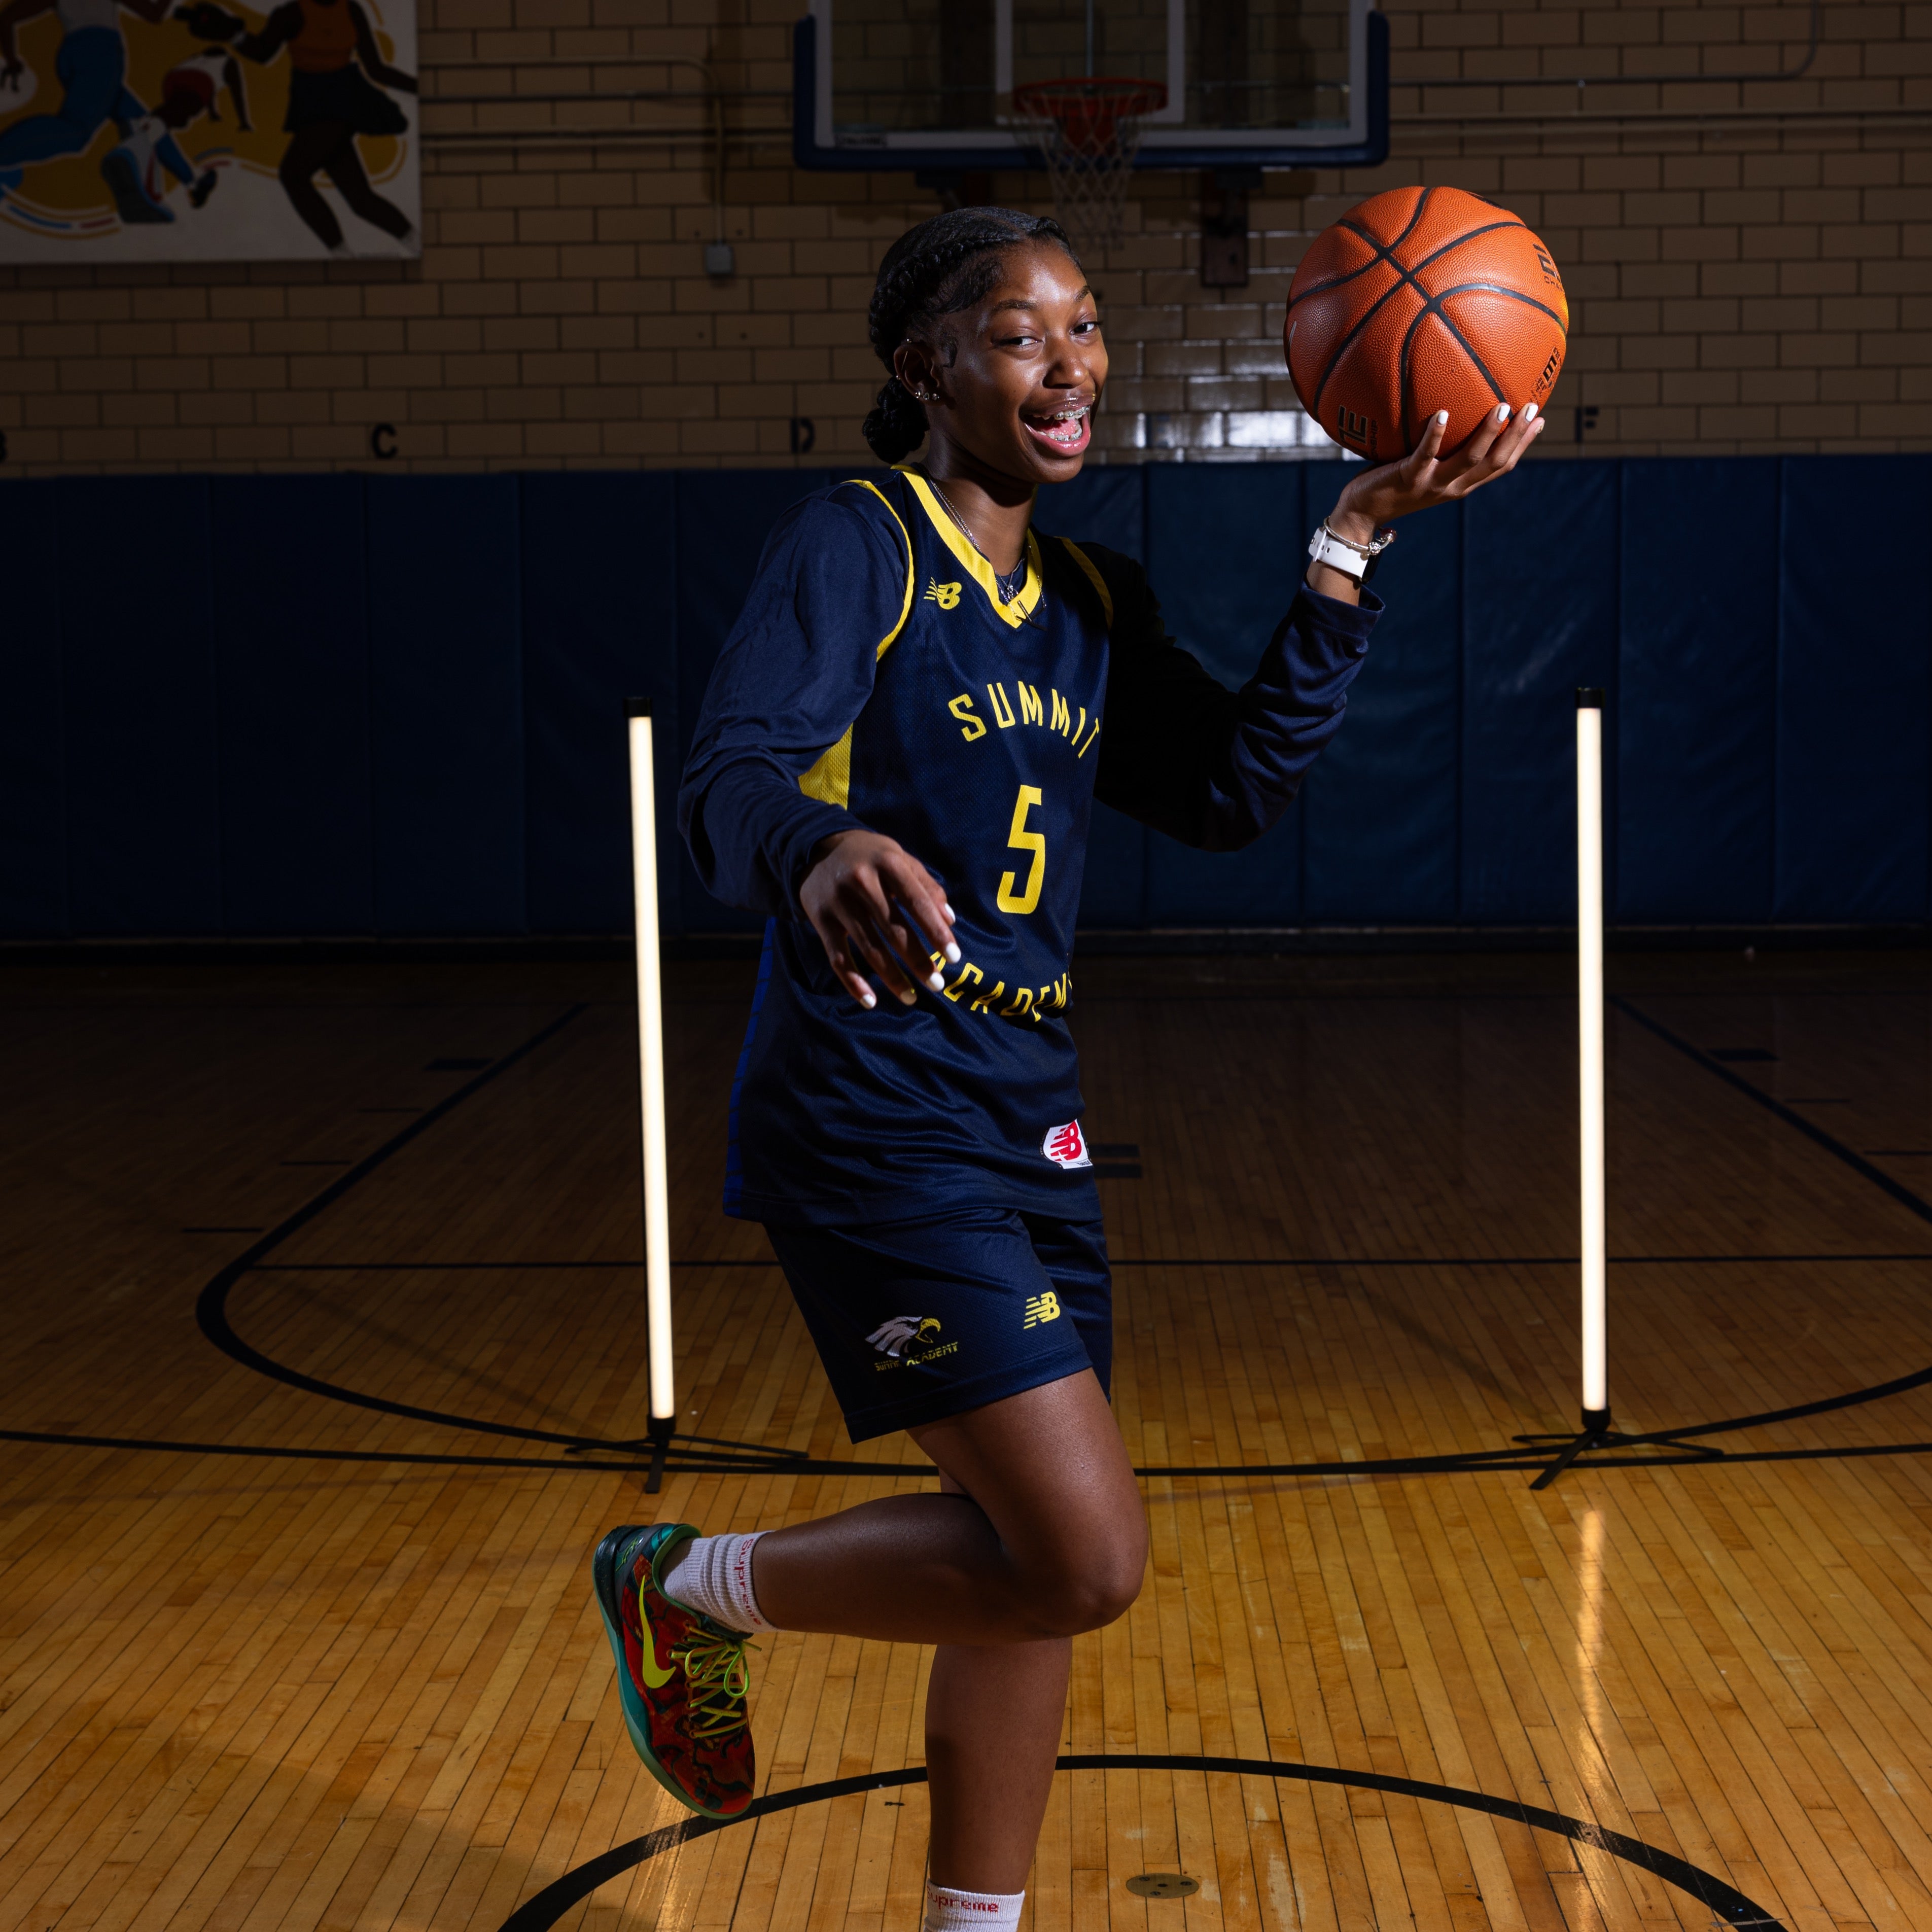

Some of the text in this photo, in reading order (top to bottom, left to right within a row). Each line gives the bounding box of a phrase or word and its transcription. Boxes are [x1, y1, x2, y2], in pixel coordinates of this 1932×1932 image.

[372, 423, 397, 459] C
[791, 417, 815, 453] D
[1576, 406, 1599, 443] F
[948, 681, 1100, 759] SUMMIT
[997, 784, 1046, 915] 5
[906, 1341, 958, 1366] ACADEMY
[734, 1538, 762, 1625] Supreme
[927, 1886, 999, 1912] Supreme
